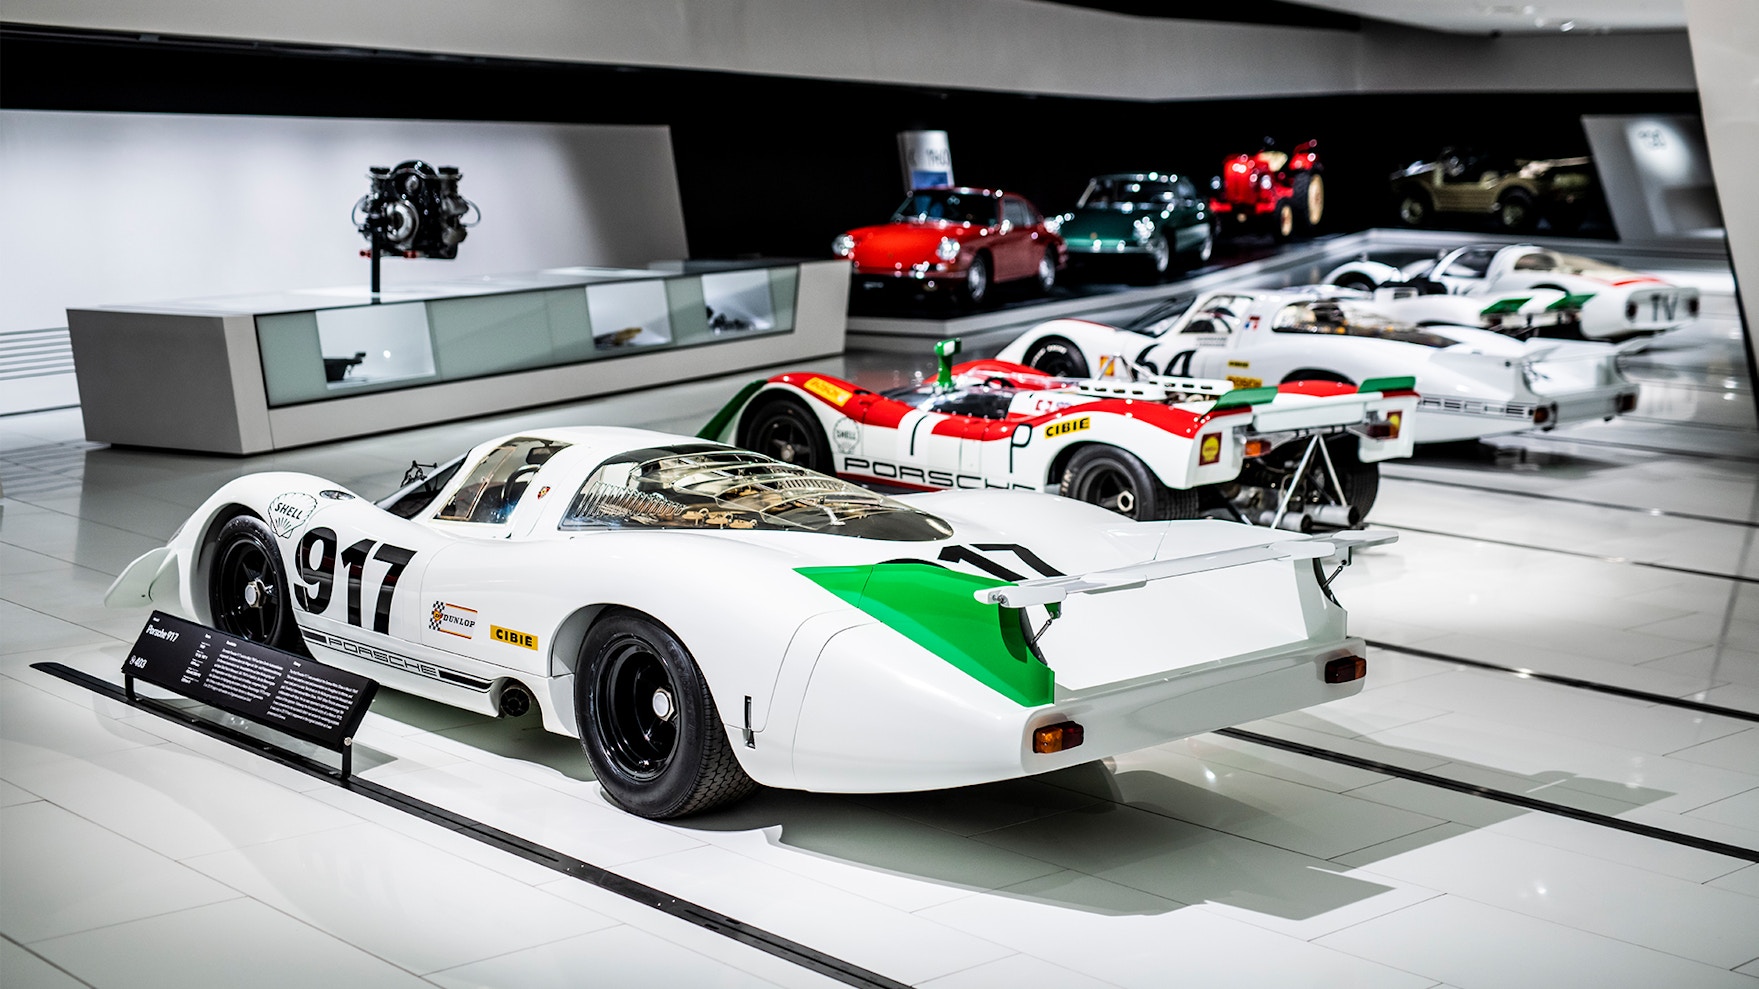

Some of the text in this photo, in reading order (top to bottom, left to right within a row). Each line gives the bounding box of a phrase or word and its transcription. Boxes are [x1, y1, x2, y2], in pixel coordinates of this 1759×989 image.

[1046, 417, 1090, 437] CIBIE
[844, 457, 1036, 491] PORSCH
[274, 502, 303, 520] SHELL
[294, 526, 418, 635] 917
[443, 613, 476, 628] DUNLOP
[146, 624, 180, 643] Porsche 917
[496, 628, 533, 647] CIBIE
[328, 637, 438, 677] PORSCHE
